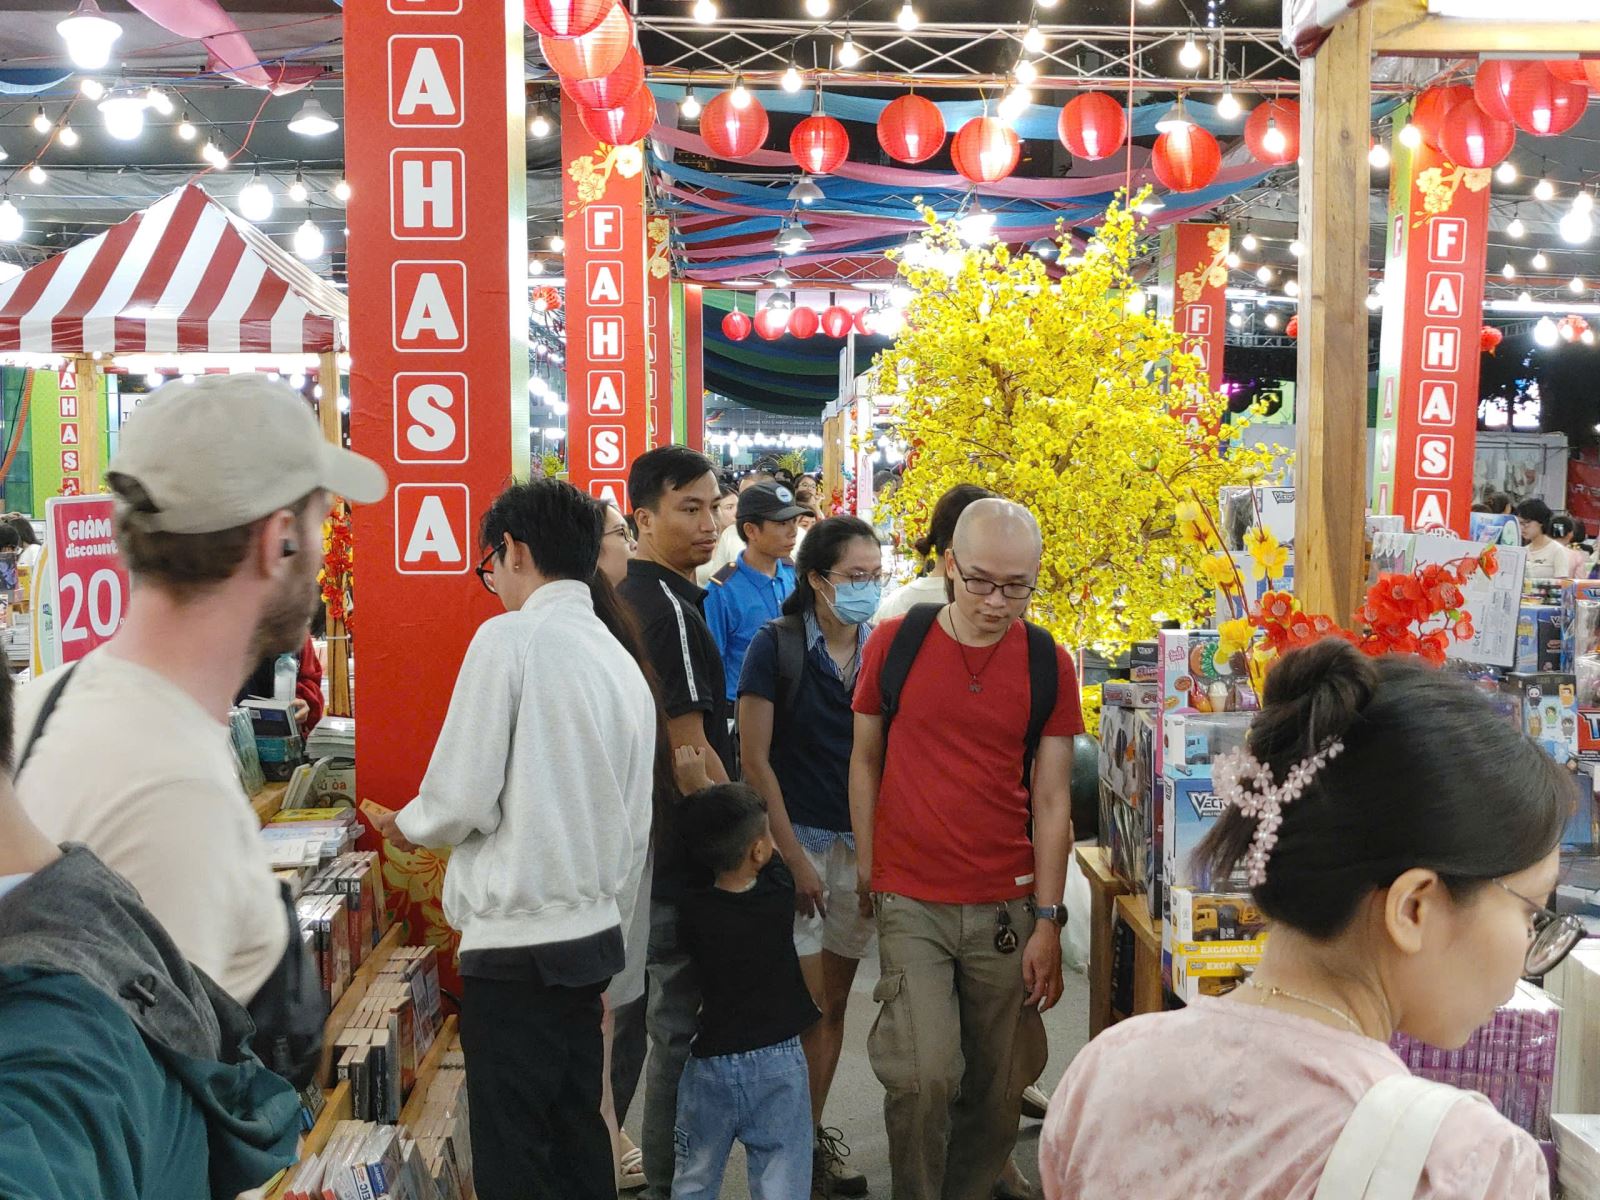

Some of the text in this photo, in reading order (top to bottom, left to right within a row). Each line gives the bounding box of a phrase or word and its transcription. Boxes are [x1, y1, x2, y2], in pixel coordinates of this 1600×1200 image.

[397, 0, 462, 562] AHASA
[1413, 222, 1458, 528] FAHASA
[65, 540, 119, 559] discount
[59, 568, 125, 643] 20
[1193, 795, 1226, 809] VECT
[1201, 944, 1256, 955] EXCAVATOR
[1206, 962, 1235, 970] EXCA
